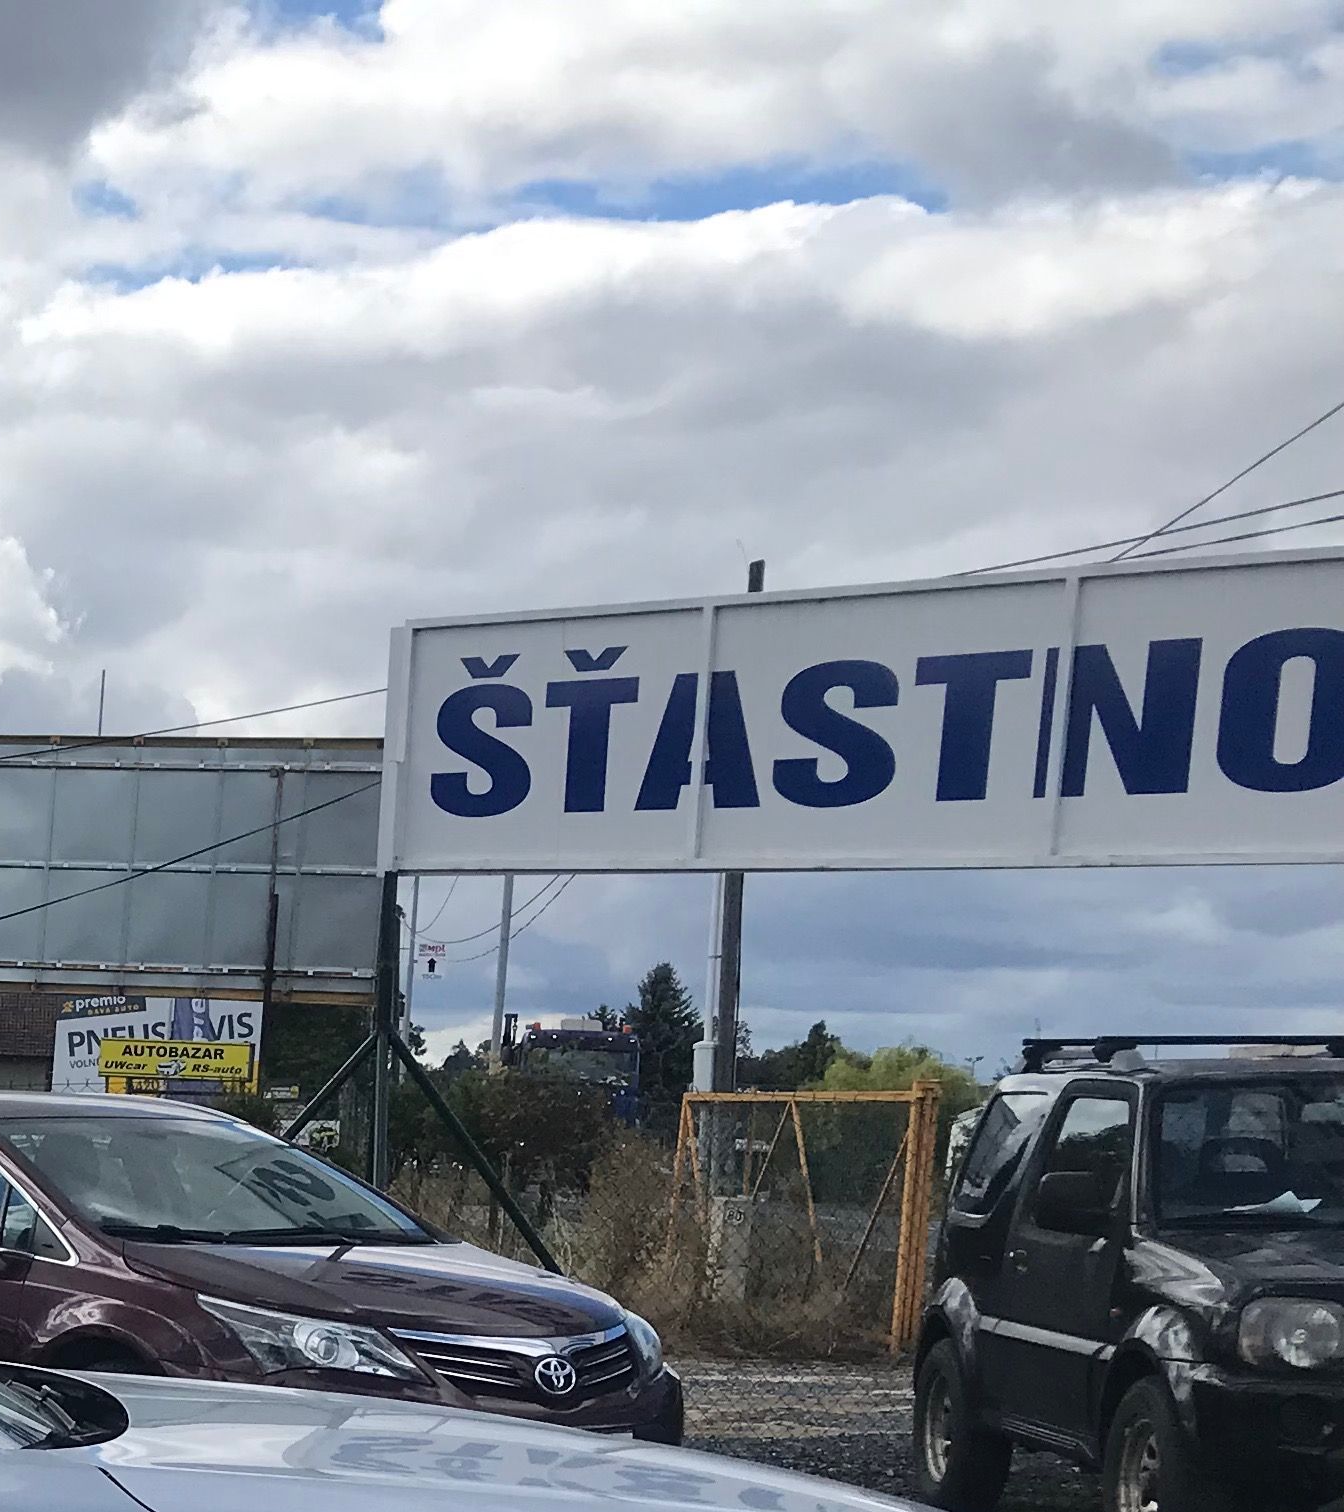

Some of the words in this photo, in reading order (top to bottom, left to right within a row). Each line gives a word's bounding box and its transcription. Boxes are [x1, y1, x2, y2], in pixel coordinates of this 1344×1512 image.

[75, 996, 126, 1012] premio
[122, 1045, 224, 1060] AUTOBAZAR
[104, 1060, 148, 1070] UWcar
[192, 1064, 242, 1074] RS-auto
